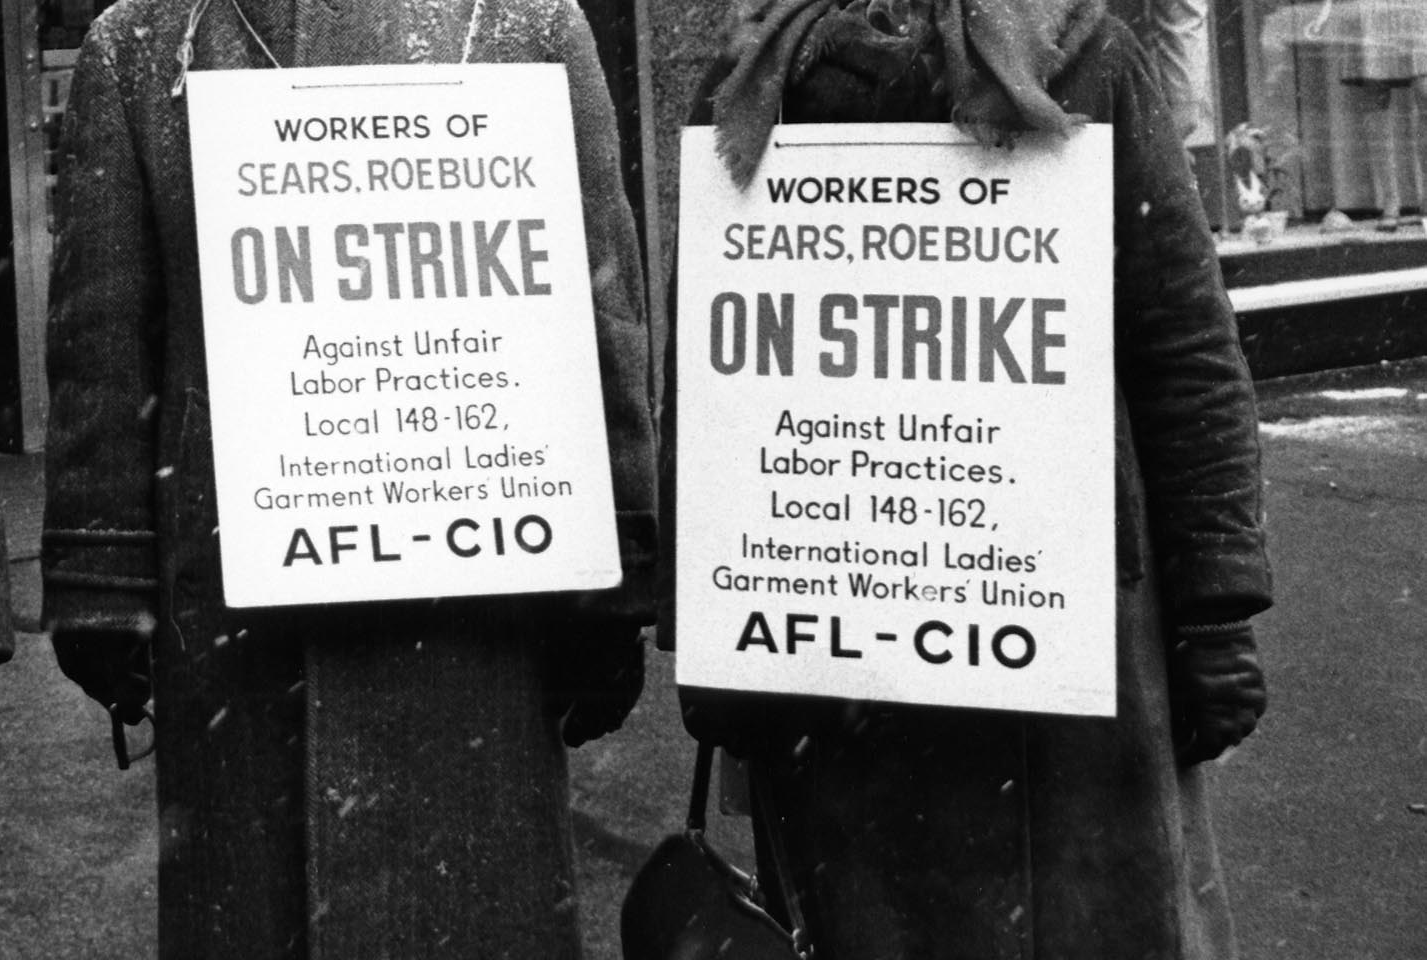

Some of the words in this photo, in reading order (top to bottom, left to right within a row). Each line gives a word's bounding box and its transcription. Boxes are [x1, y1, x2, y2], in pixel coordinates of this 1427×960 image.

[274, 115, 430, 142] WORKERS
[446, 114, 487, 138] OF
[368, 156, 535, 191] ROEBUCK
[766, 176, 941, 205] WORKERS
[959, 177, 1011, 205] OF
[723, 223, 854, 263] SEARS,
[862, 223, 1059, 264] ROEBUCK
[231, 226, 313, 304] ON
[335, 219, 551, 300] STRIKE
[303, 335, 402, 365] Against
[415, 328, 502, 355] Unfair
[710, 292, 795, 377] ON
[819, 293, 1066, 385] STRIKE
[291, 371, 365, 395] Labor
[376, 367, 519, 391] Practices.
[305, 410, 378, 436] Local
[396, 403, 508, 432] 148-162,
[775, 409, 885, 445] Against
[899, 414, 1001, 444] Unfair
[281, 447, 450, 476] International
[760, 447, 841, 476] Labor
[851, 450, 1015, 484] Practices.
[254, 486, 372, 509] Garment
[501, 477, 572, 498] Union
[771, 490, 850, 521] Local
[870, 495, 998, 531] 148-162,
[742, 533, 928, 567] International
[712, 565, 838, 596] Garment
[982, 580, 1065, 609] Union
